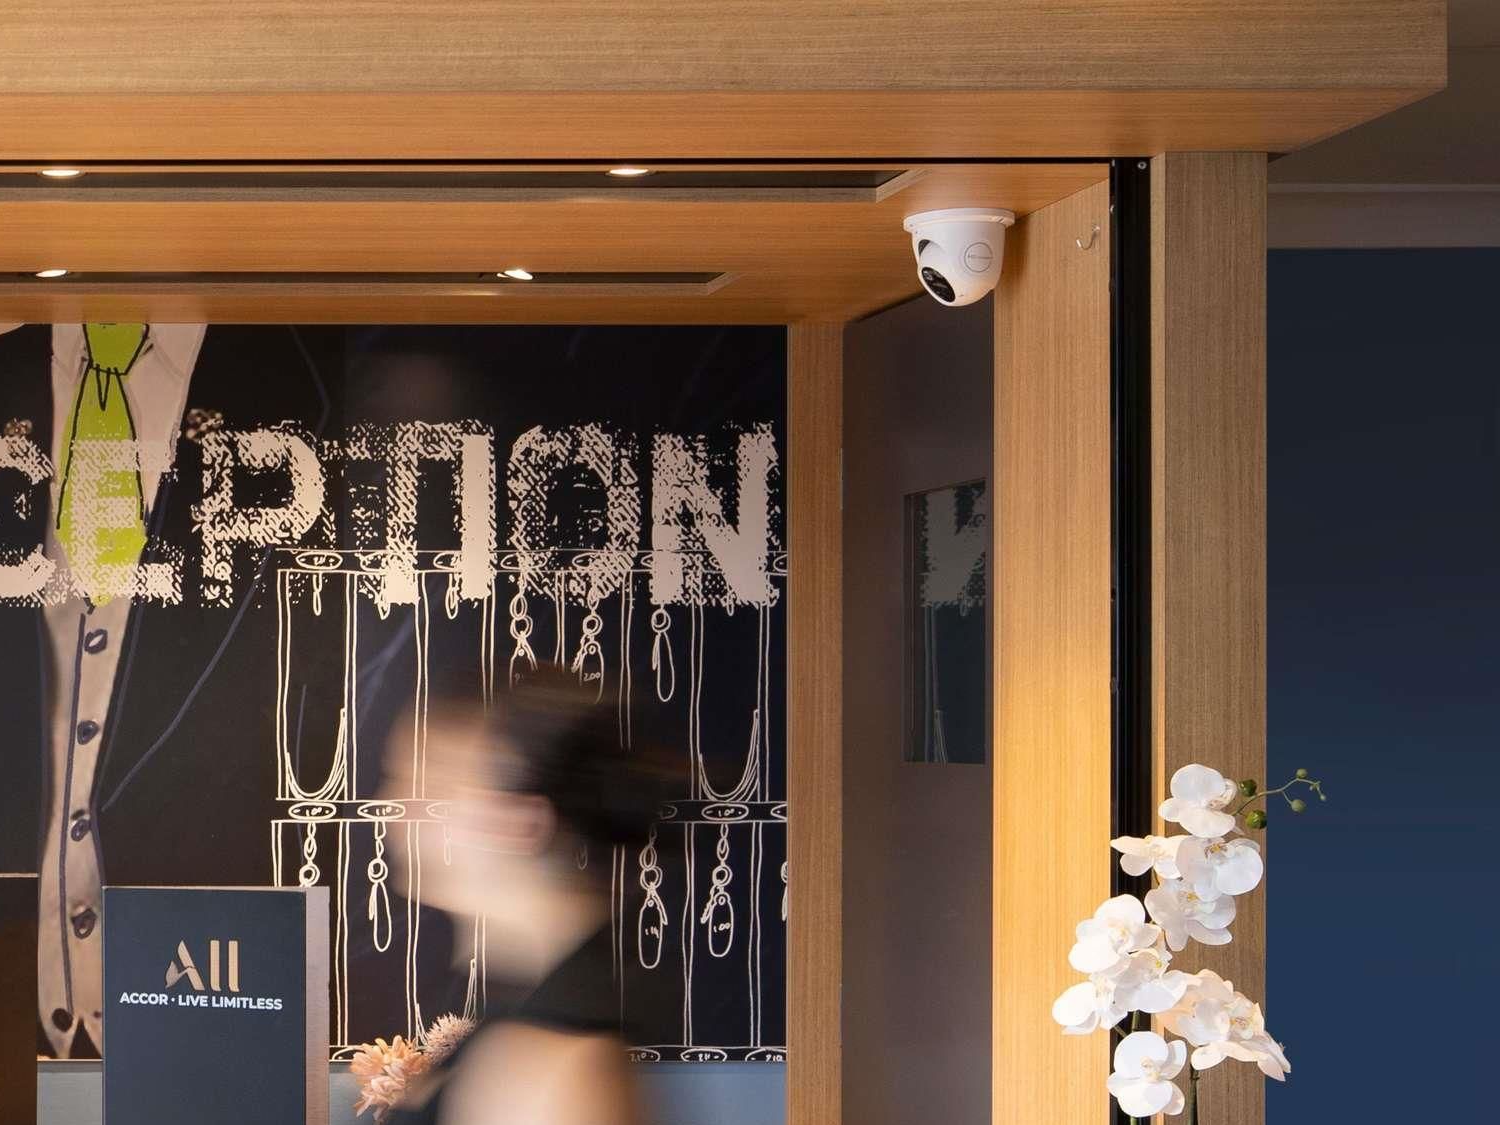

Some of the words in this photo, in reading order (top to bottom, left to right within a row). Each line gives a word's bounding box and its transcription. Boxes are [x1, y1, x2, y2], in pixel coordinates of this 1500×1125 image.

[119, 992, 168, 1005] ACCOR
[178, 995, 208, 1007] LIVE
[212, 996, 283, 1010] LIMITLESS
